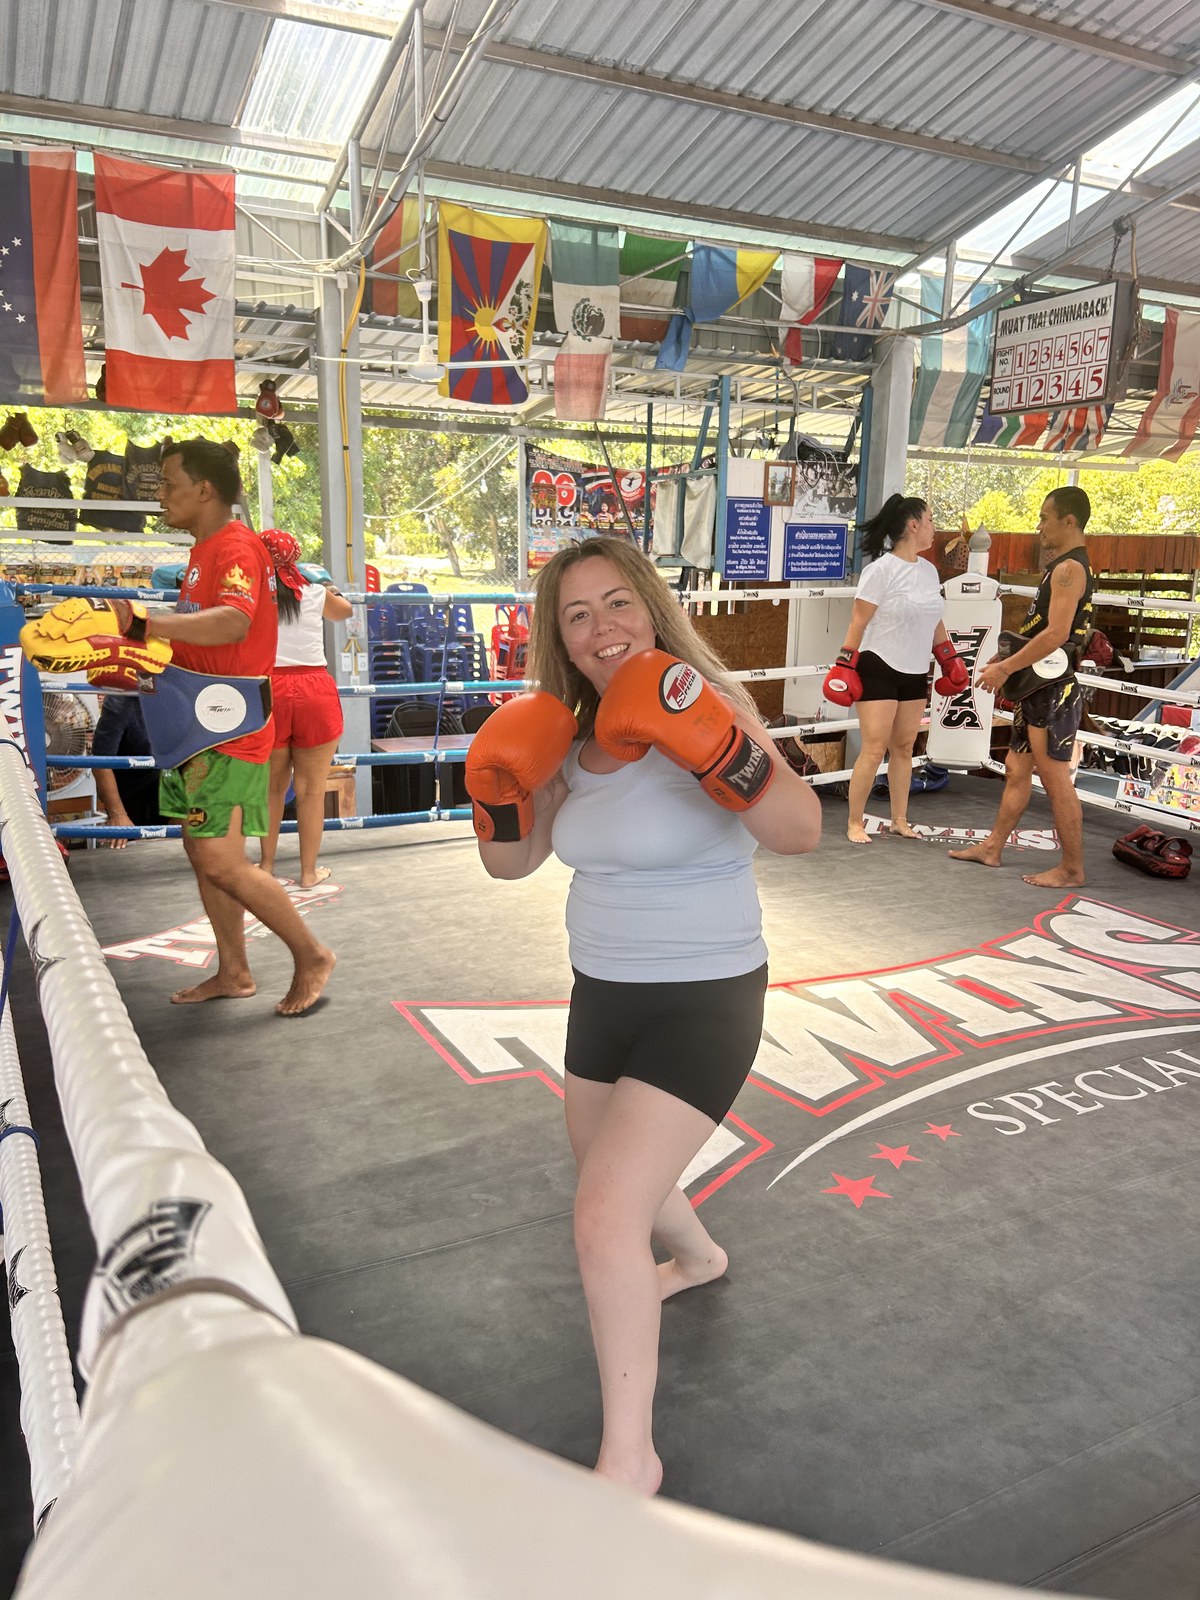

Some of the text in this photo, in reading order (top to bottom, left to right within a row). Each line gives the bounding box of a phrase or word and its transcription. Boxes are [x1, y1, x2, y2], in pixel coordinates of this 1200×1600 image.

[1000, 317, 1025, 336] MUAY
[1027, 311, 1047, 330] THAI
[997, 335, 1109, 368] FIGHT 1 2 3 4 5 6 7
[993, 368, 1103, 405] ROUND 1 2 3 4 5
[742, 590, 759, 599] TWINS
[809, 589, 825, 597] TWINS
[1127, 597, 1145, 607] TWINS
[750, 668, 766, 678] TWINS
[942, 628, 989, 728] TWNS
[666, 665, 693, 708] TWINS
[1120, 682, 1138, 693] TWINS
[800, 726, 815, 735] TWINS
[1114, 740, 1133, 751] TWINS
[728, 737, 765, 791] TWINS
[1114, 800, 1133, 813] TWINS
